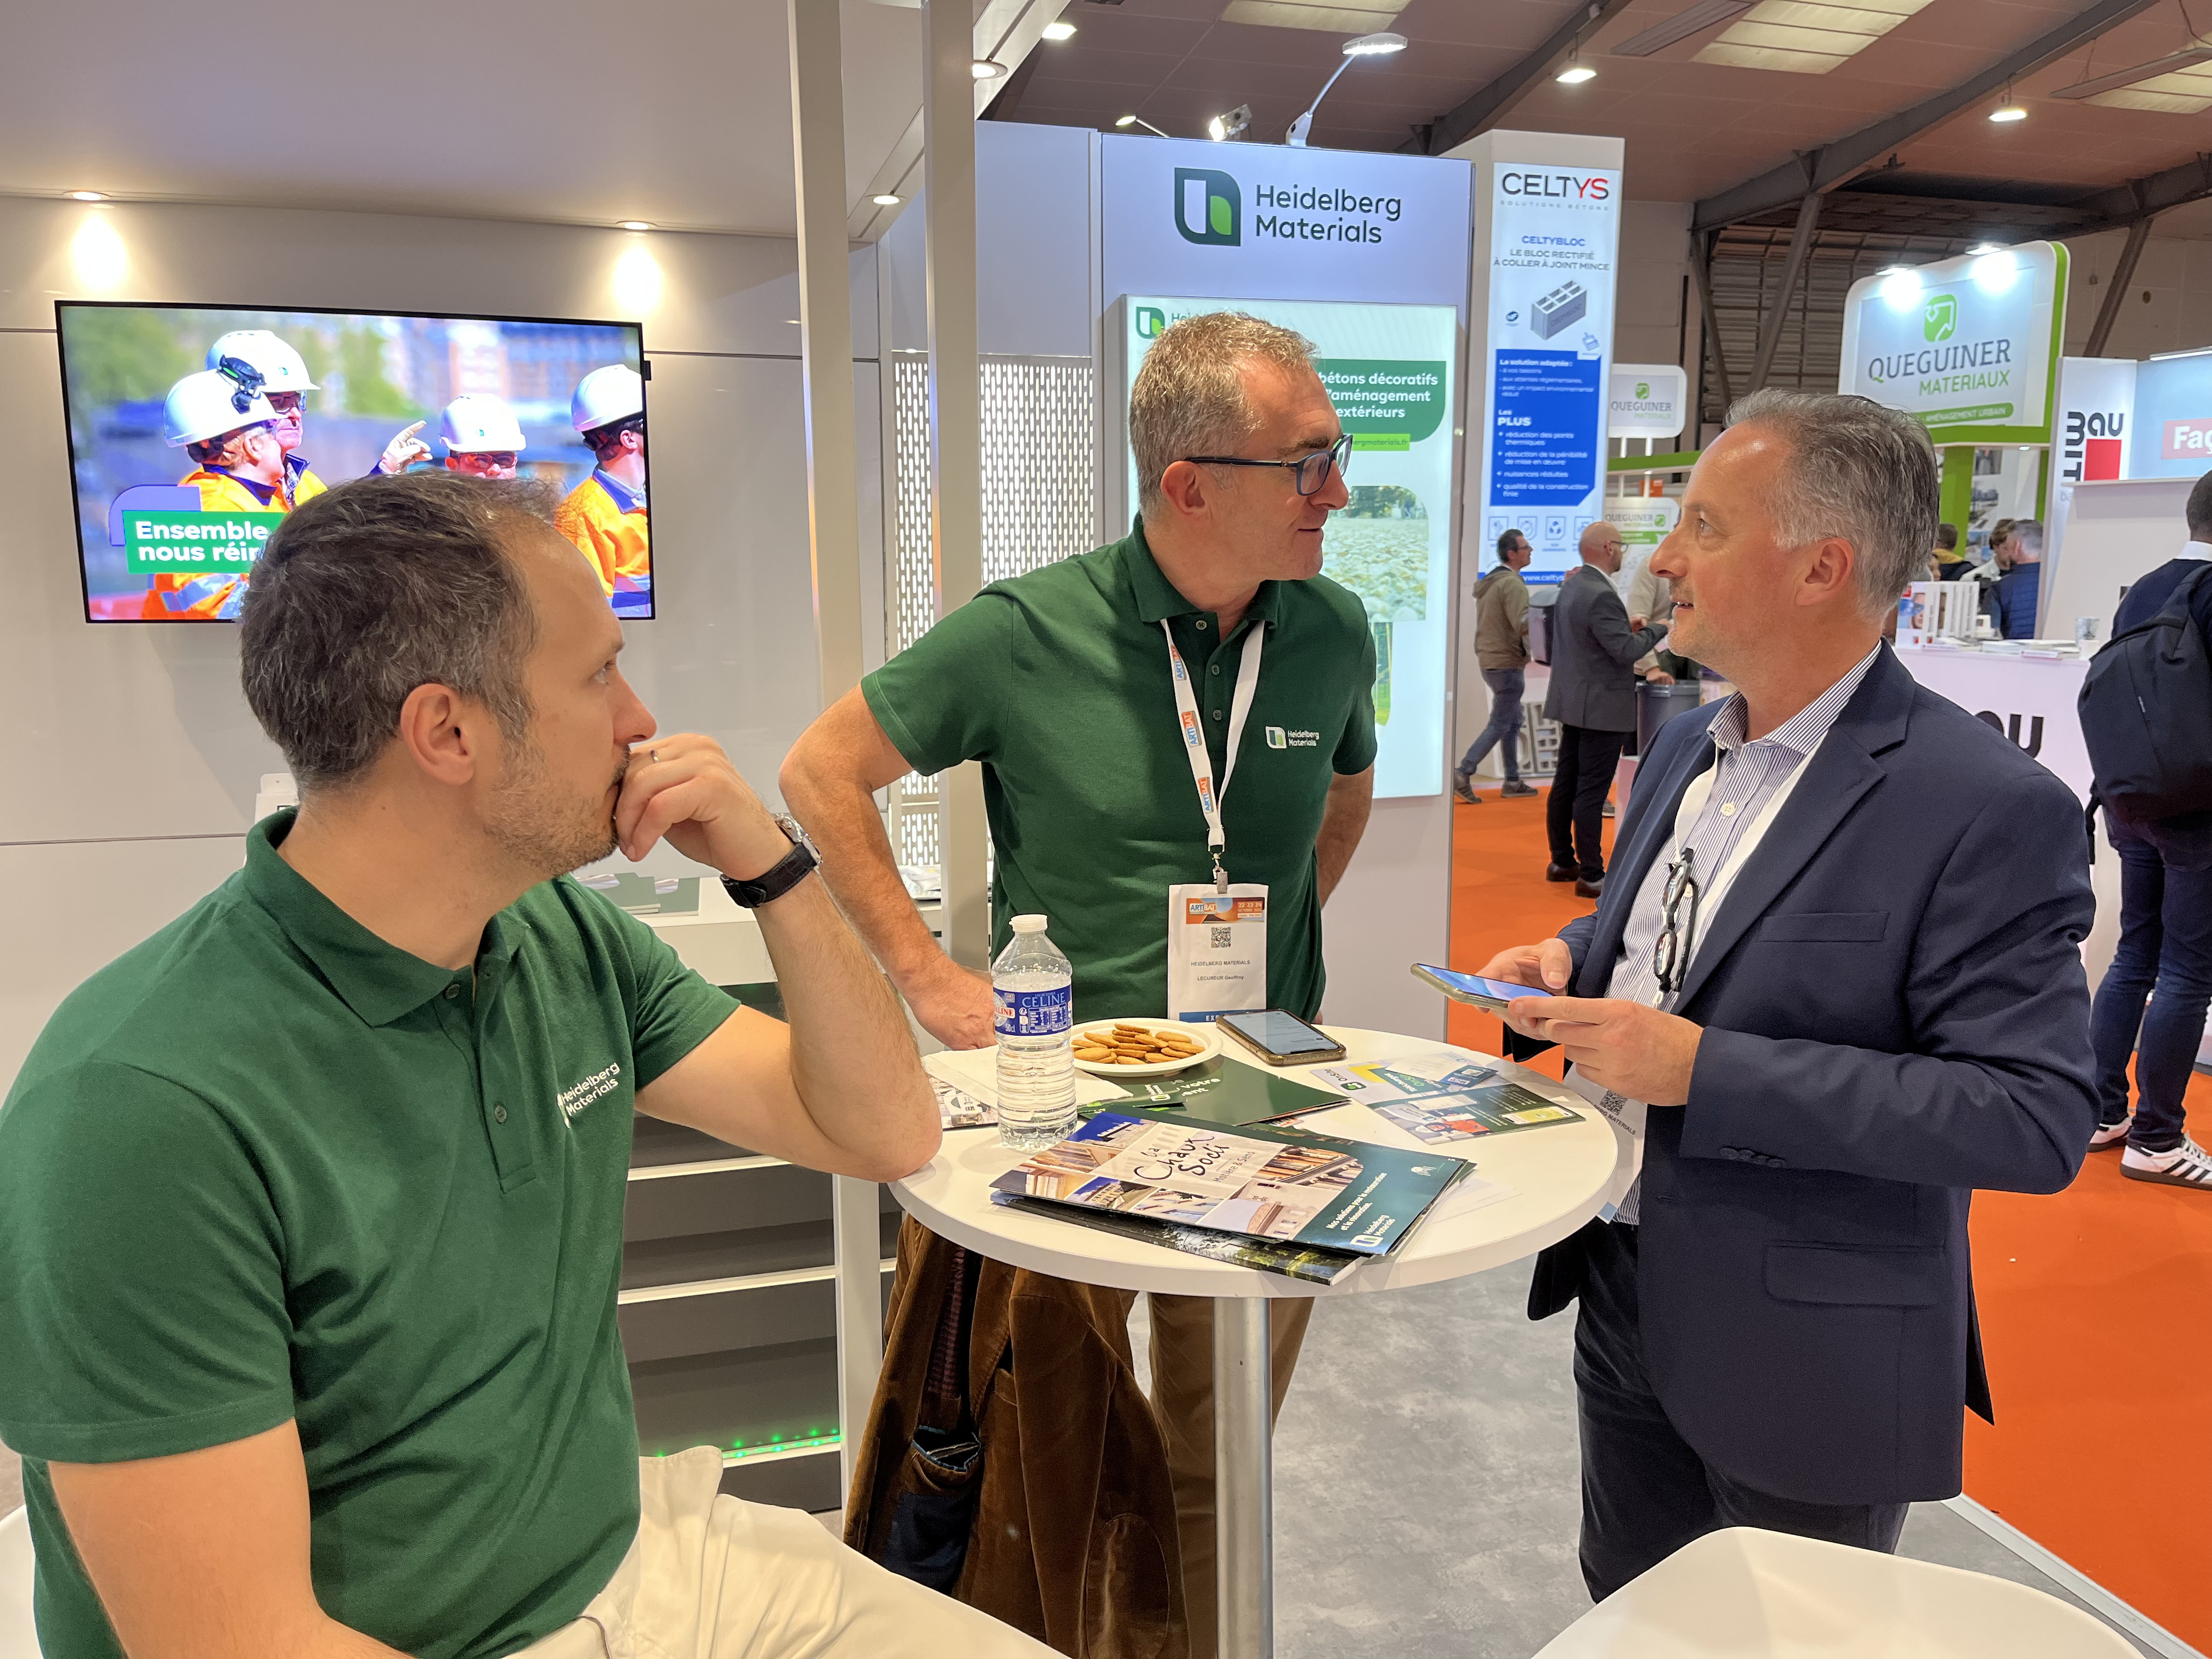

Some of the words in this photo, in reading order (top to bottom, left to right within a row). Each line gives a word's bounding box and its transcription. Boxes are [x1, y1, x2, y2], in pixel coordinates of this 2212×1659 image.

[1502, 173, 1609, 200] CELTYS
[1256, 184, 1401, 221] Heidelberg
[1256, 215, 1382, 244] Materials
[1522, 236, 1585, 246] CELTYBLOC
[1493, 257, 1500, 266] À
[1541, 258, 1548, 267] À
[1551, 251, 1595, 259] RECTIFIÉ
[1869, 339, 2011, 383] QUEGUINER
[1368, 373, 1438, 385] décoratifs
[1919, 370, 2010, 396] MATERIAUX
[1325, 388, 1431, 404] 'aménagement
[1335, 405, 1405, 417] extérieurs
[1611, 402, 1672, 411] QUEGUINER
[1497, 417, 1531, 426] PLUS
[1605, 514, 1654, 522] QUEGUINER
[136, 521, 268, 540] Ensemble
[138, 546, 205, 561] nous
[1183, 712, 1198, 745] ARTIBAT
[1288, 730, 1319, 740] Heidelberg
[1288, 738, 1317, 747] Materials
[1200, 778, 1211, 811] ARTIBAT
[1190, 904, 1216, 912] ARTIBAT
[1022, 992, 1066, 1008] CELINE
[994, 1005, 1014, 1017] ALINE
[561, 1062, 620, 1104] Heidelberg
[565, 1078, 619, 1116] Materials
[1608, 1114, 1636, 1135] MATERIALS
[1133, 1136, 1215, 1180] Chaux
[1212, 1165, 1235, 1182] Matière
[1237, 1152, 1255, 1162] Sens
[1326, 1220, 1340, 1229] Nos
[1335, 1204, 1356, 1222] solutions
[1351, 1196, 1363, 1206] pour
[1363, 1172, 1387, 1194] restauration
[1363, 1215, 1390, 1234] Heidelberg
